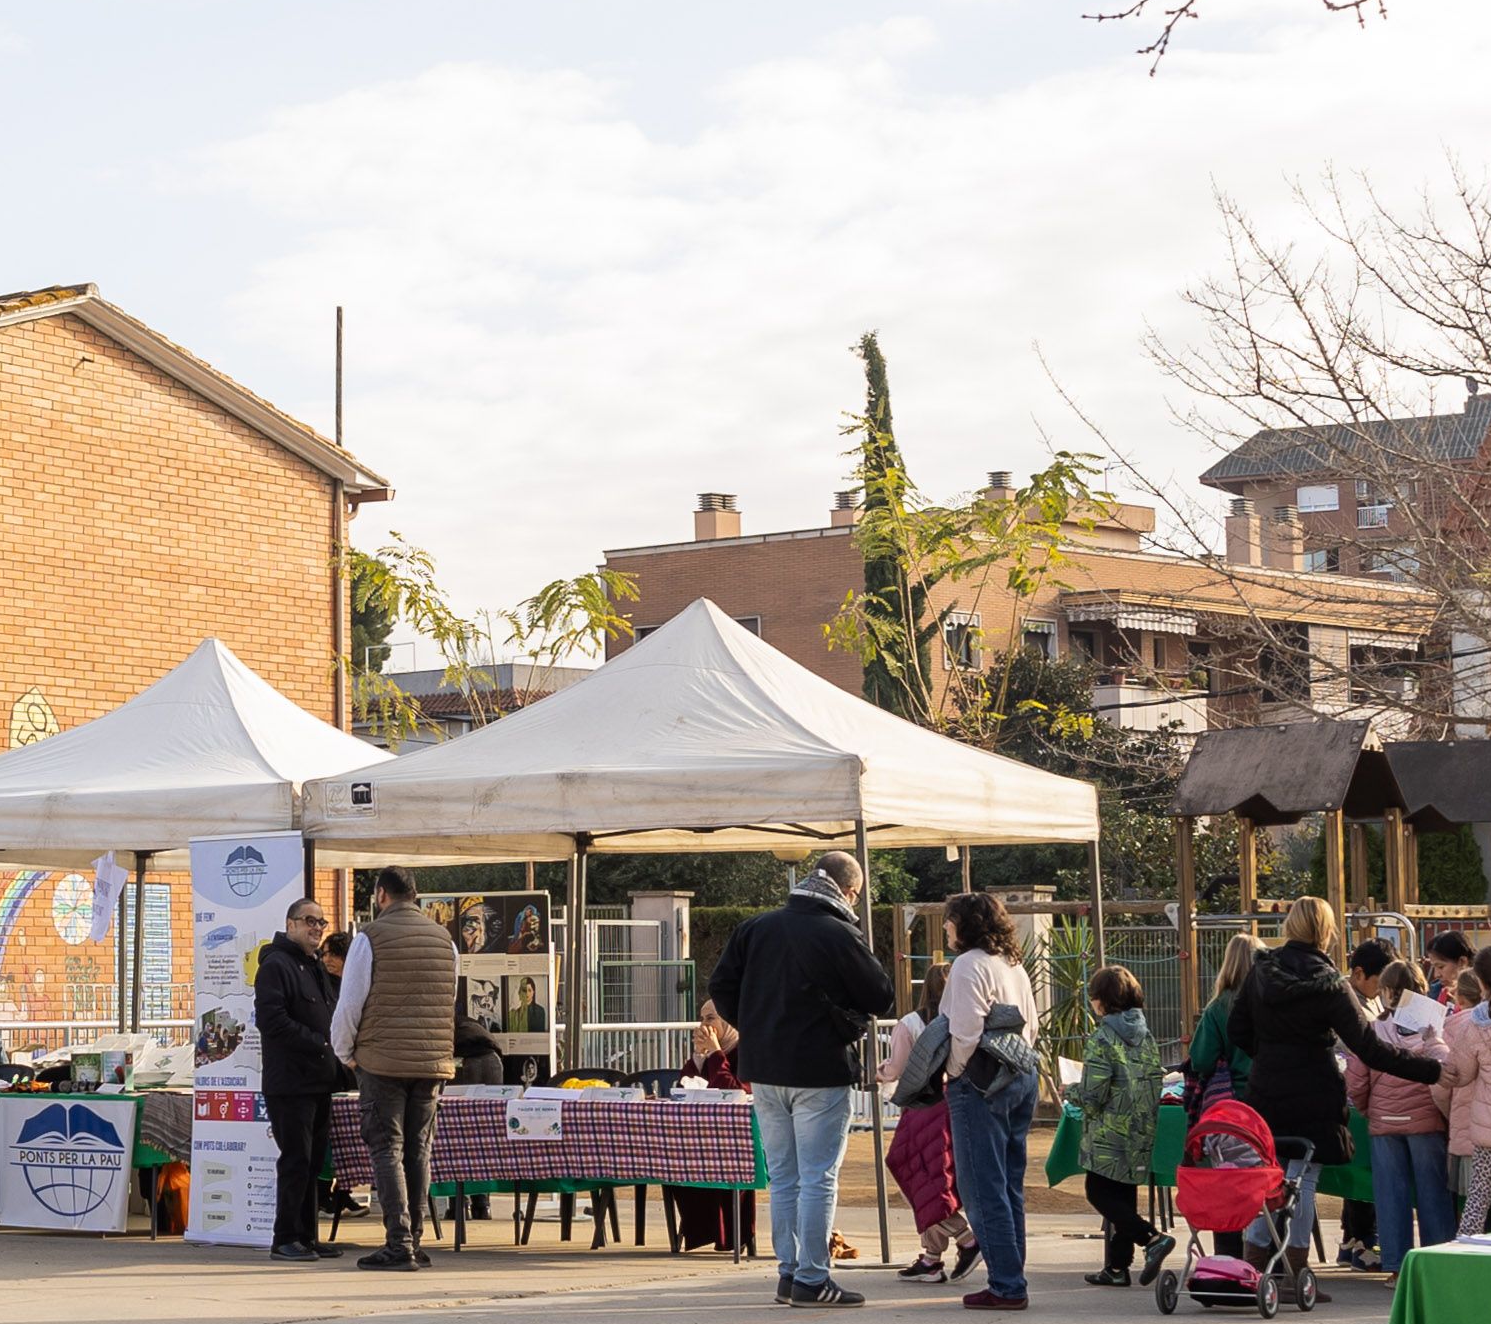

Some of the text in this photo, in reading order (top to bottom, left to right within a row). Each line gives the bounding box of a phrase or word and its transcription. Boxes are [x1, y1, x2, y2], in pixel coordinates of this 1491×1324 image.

[19, 1150, 121, 1167] PONTS PER LA PAU
